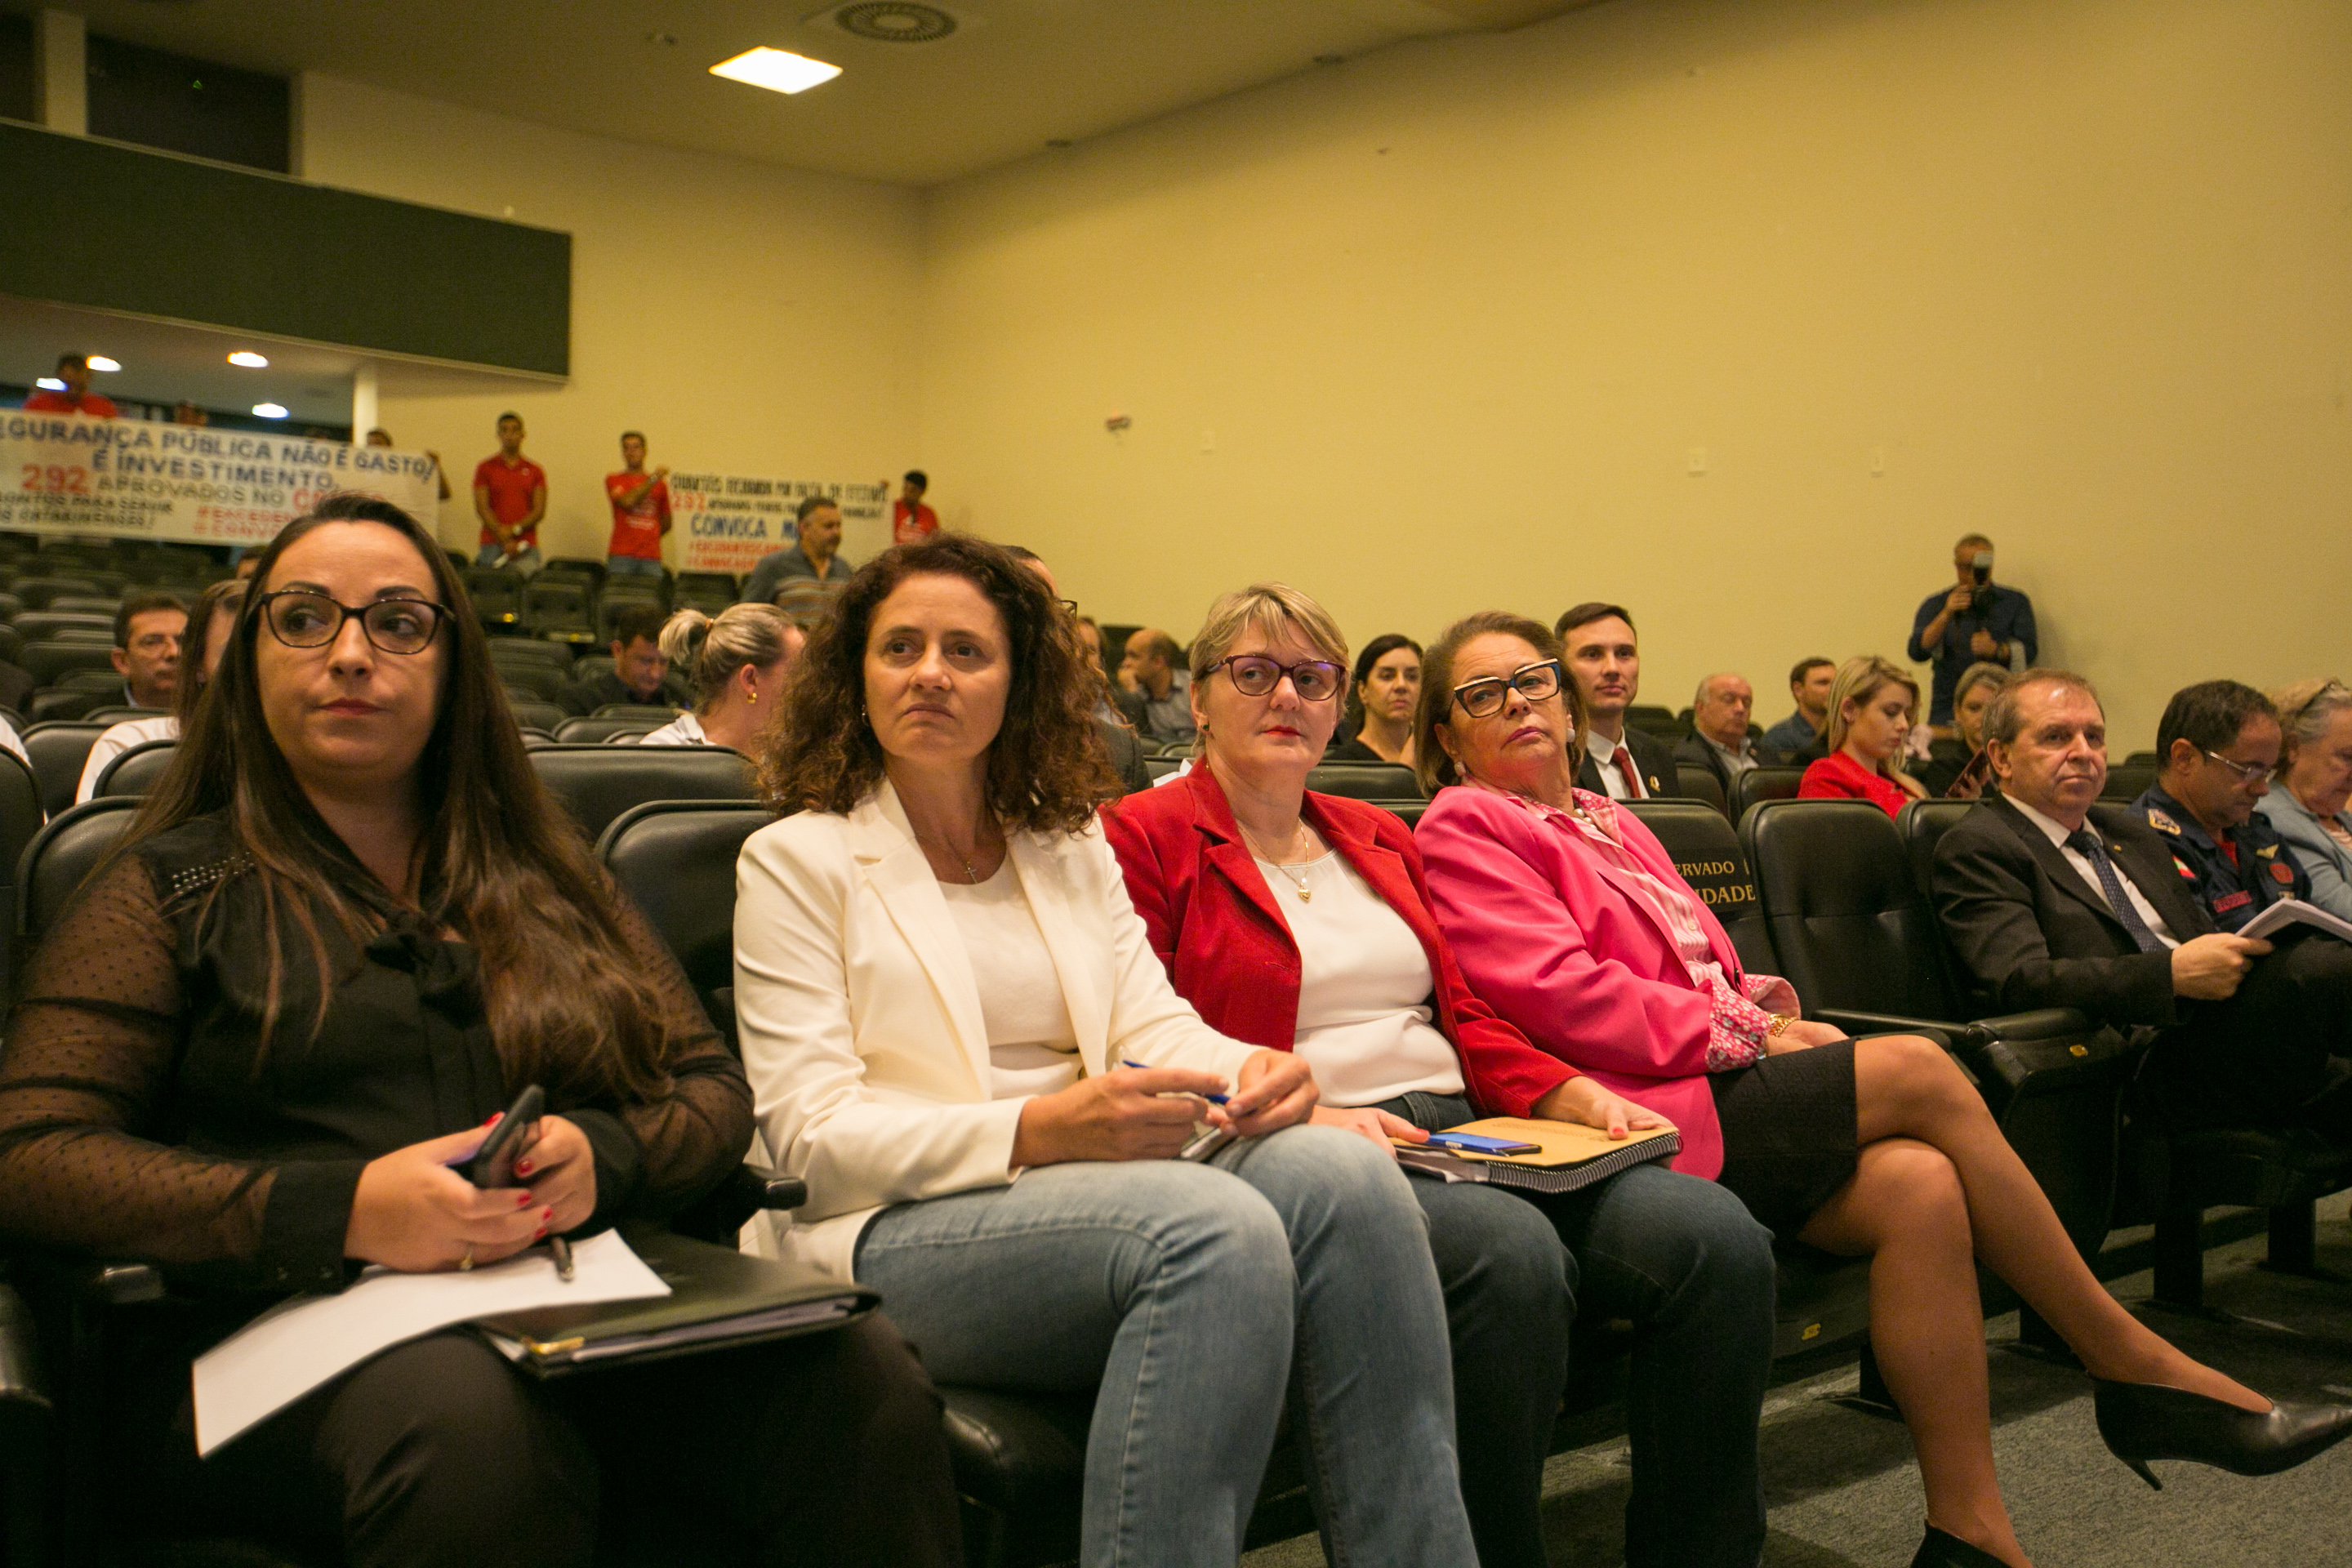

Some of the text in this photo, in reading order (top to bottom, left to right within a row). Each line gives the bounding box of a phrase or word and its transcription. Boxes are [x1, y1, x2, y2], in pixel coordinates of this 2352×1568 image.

[91, 446, 108, 471] É
[161, 426, 272, 461] PÚBLICA
[281, 438, 332, 467] NÃO
[335, 442, 349, 469] É
[21, 462, 90, 495] 292
[96, 474, 245, 506] APROVADOS
[252, 488, 284, 510] NO
[690, 512, 767, 537] CONVOCA
